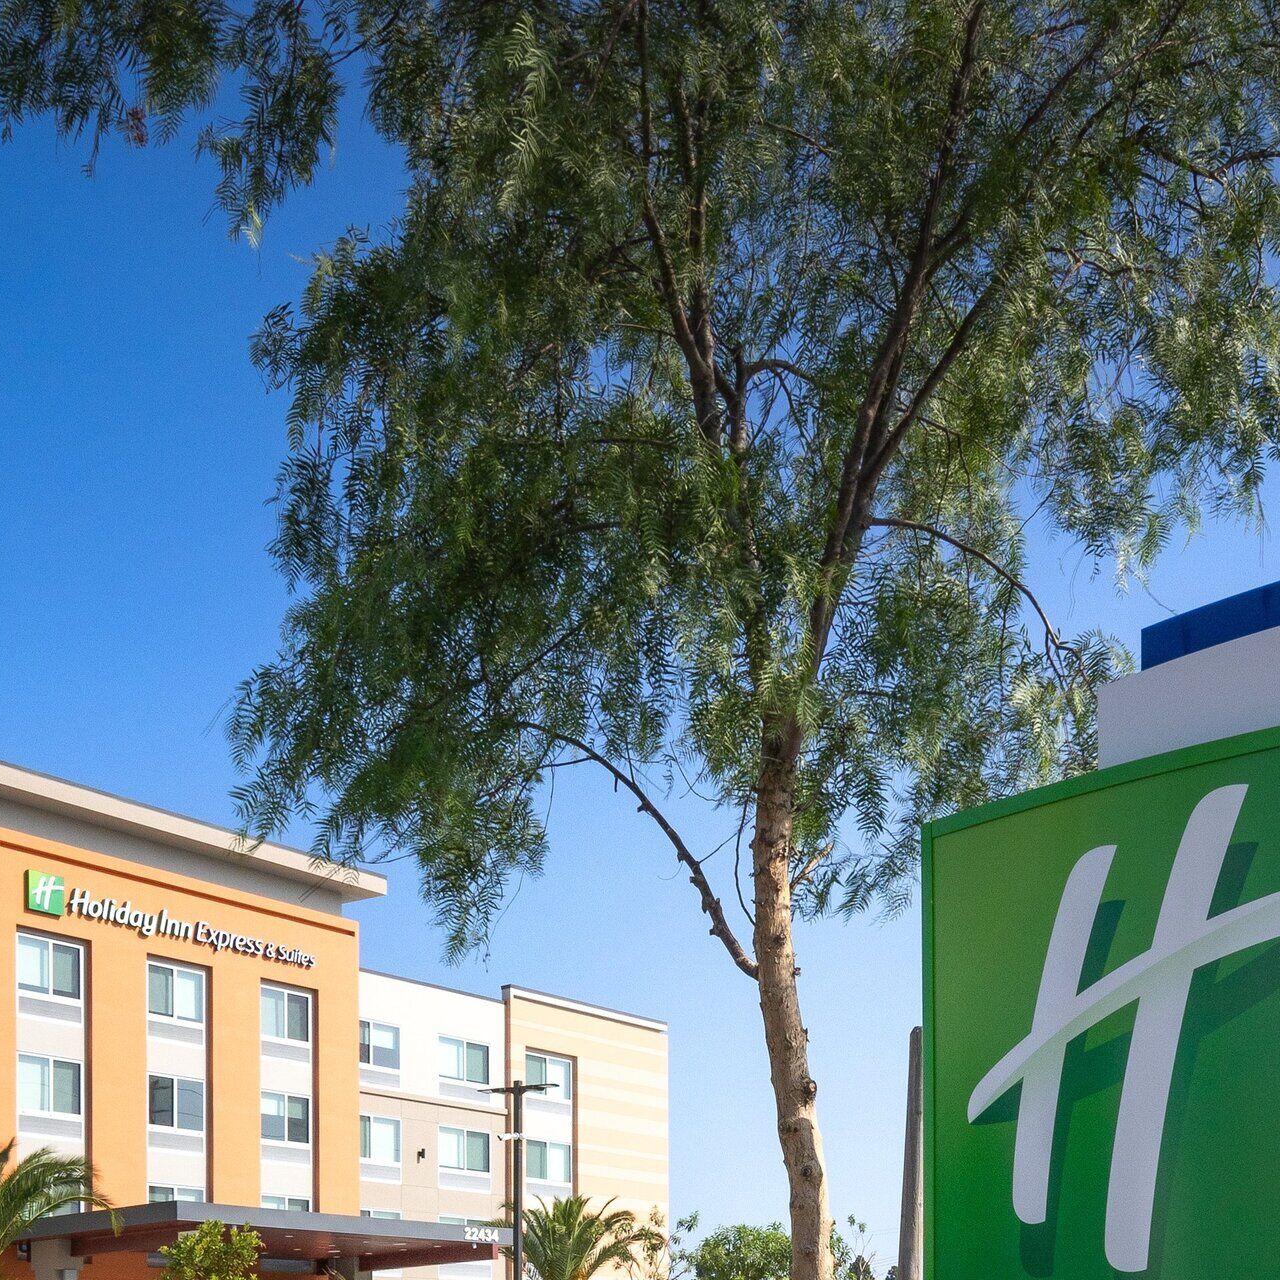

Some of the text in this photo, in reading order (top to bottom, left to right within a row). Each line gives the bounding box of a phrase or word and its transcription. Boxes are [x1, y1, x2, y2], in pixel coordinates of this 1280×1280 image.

[70, 887, 317, 967] Holiday Inn Express & Suites
[464, 1226, 499, 1243] 22434
